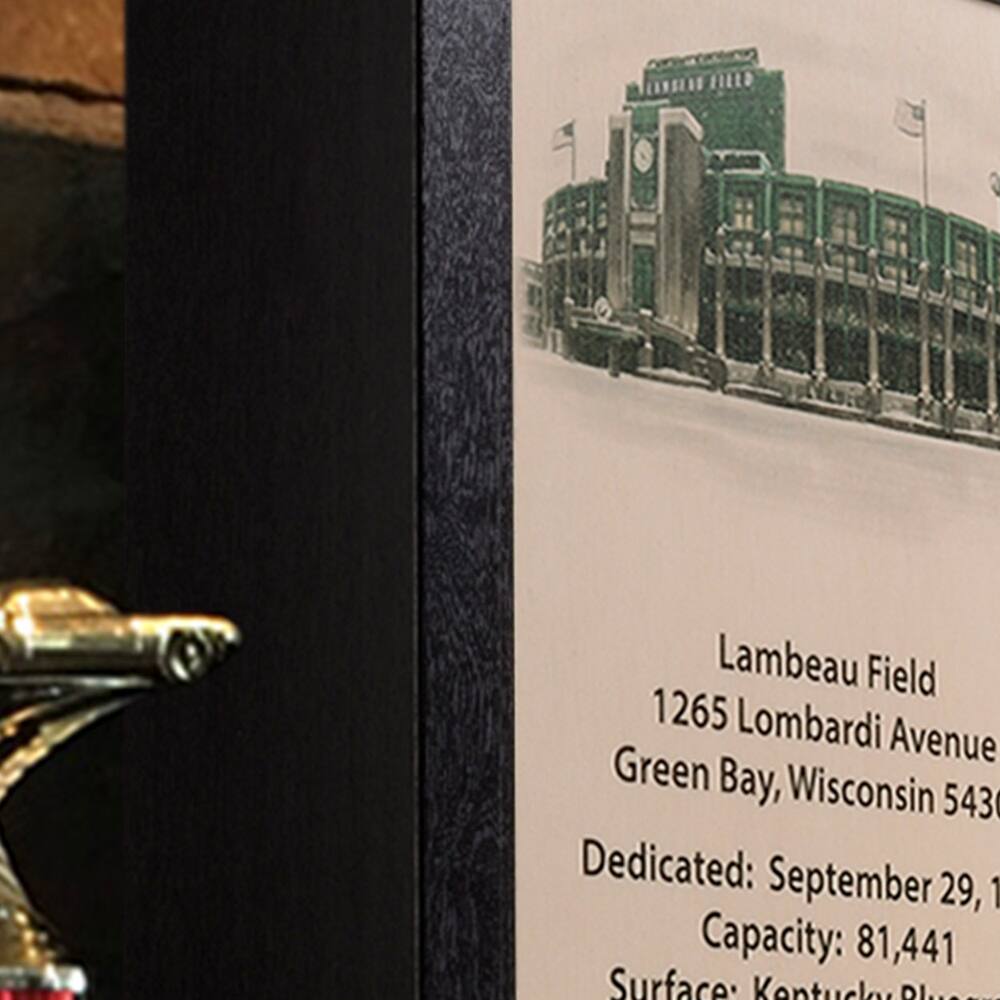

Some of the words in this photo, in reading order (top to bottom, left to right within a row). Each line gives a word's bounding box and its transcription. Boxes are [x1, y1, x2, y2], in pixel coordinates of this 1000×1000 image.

[719, 632, 859, 687] Lambeau
[868, 653, 936, 697] Field
[653, 687, 729, 731] 1265
[738, 696, 881, 750] Lombardi
[889, 716, 997, 763] Avenue
[613, 744, 710, 791] Green
[719, 755, 781, 808] Bay,
[787, 763, 935, 814] Wisconsin
[582, 837, 754, 890] Dedicated:
[769, 854, 933, 905] September
[940, 870, 982, 913] 29,
[701, 910, 843, 966] Capacity:
[857, 922, 953, 966] 81,441
